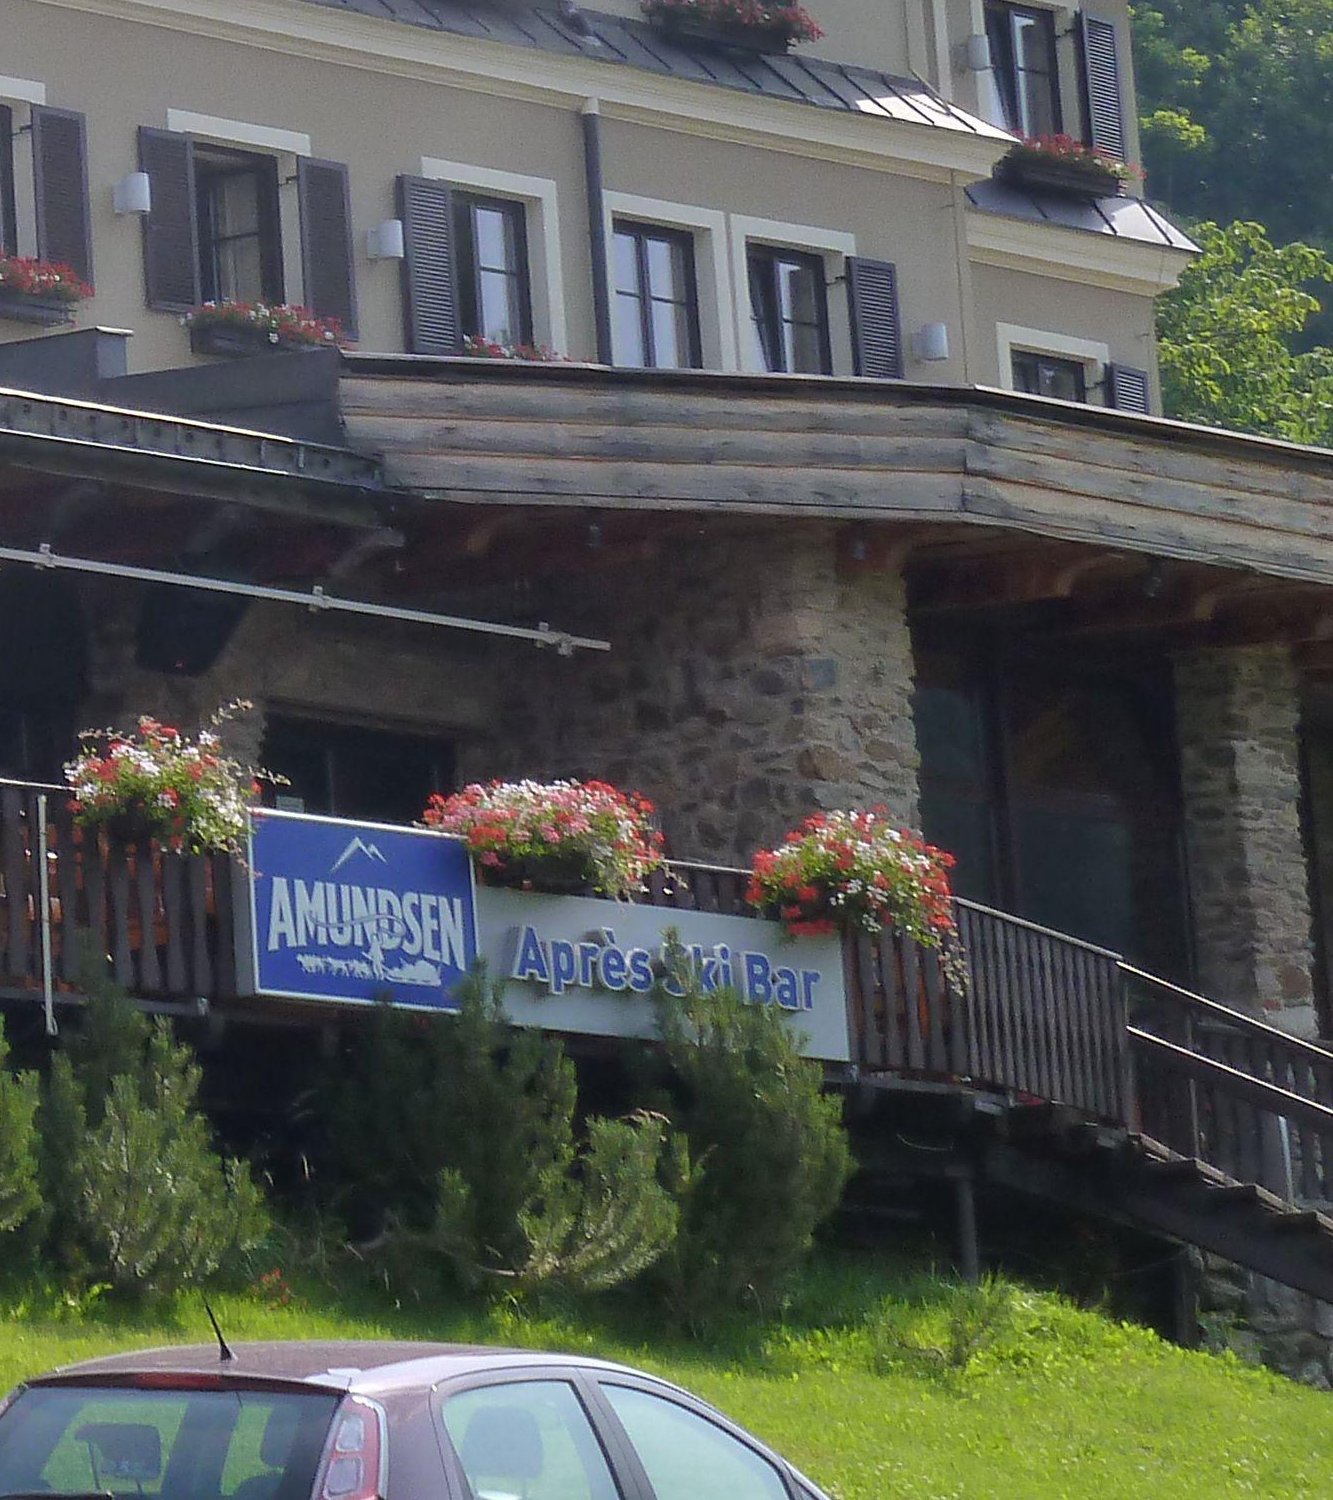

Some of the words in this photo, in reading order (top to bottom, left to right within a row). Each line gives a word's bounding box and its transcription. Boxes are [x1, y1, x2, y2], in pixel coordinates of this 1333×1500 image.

[267, 876, 466, 971] AMUNDSEN
[511, 925, 654, 995] Après
[744, 951, 821, 1011] Bar
